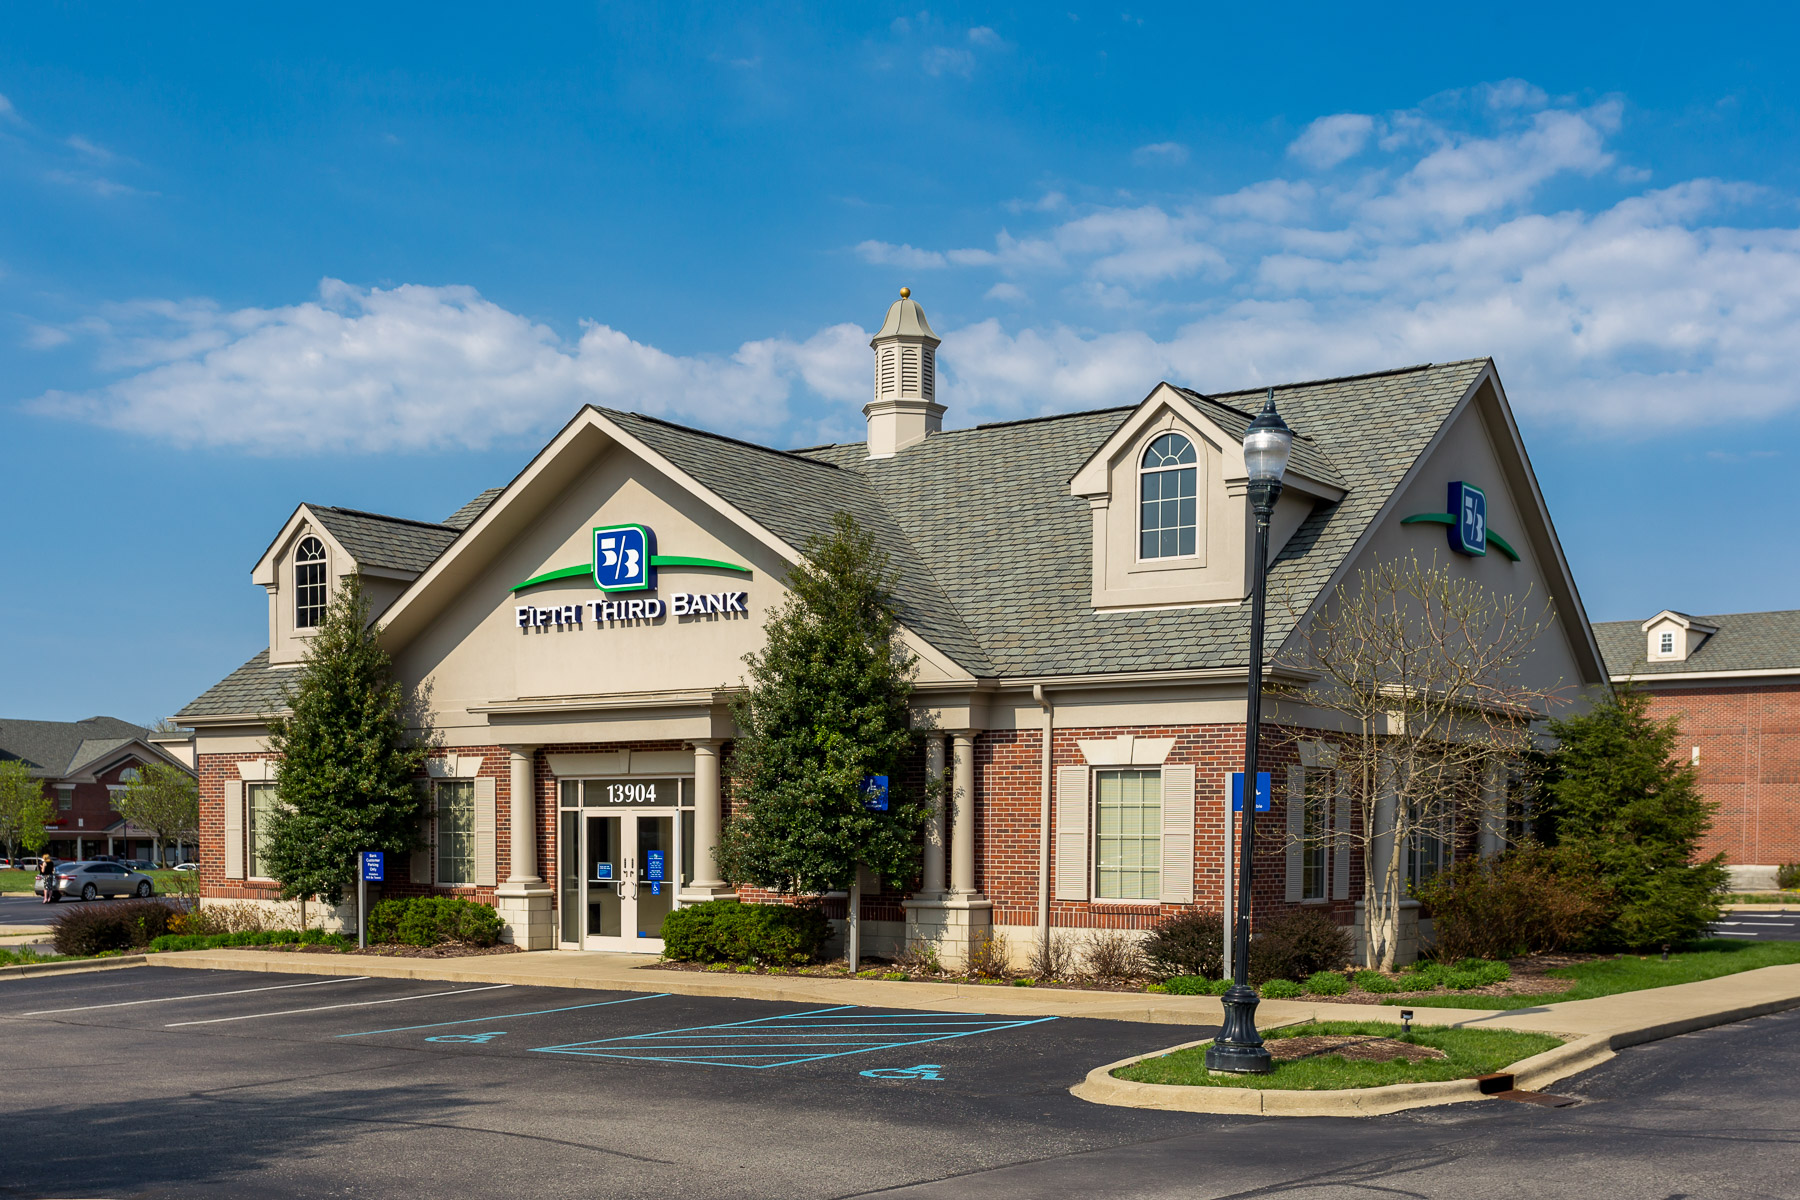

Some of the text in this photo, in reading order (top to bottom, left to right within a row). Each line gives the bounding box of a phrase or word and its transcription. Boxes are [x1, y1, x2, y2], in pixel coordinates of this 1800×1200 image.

[514, 591, 748, 628] FIFTH THIRD BANK
[606, 783, 657, 803] 13904
